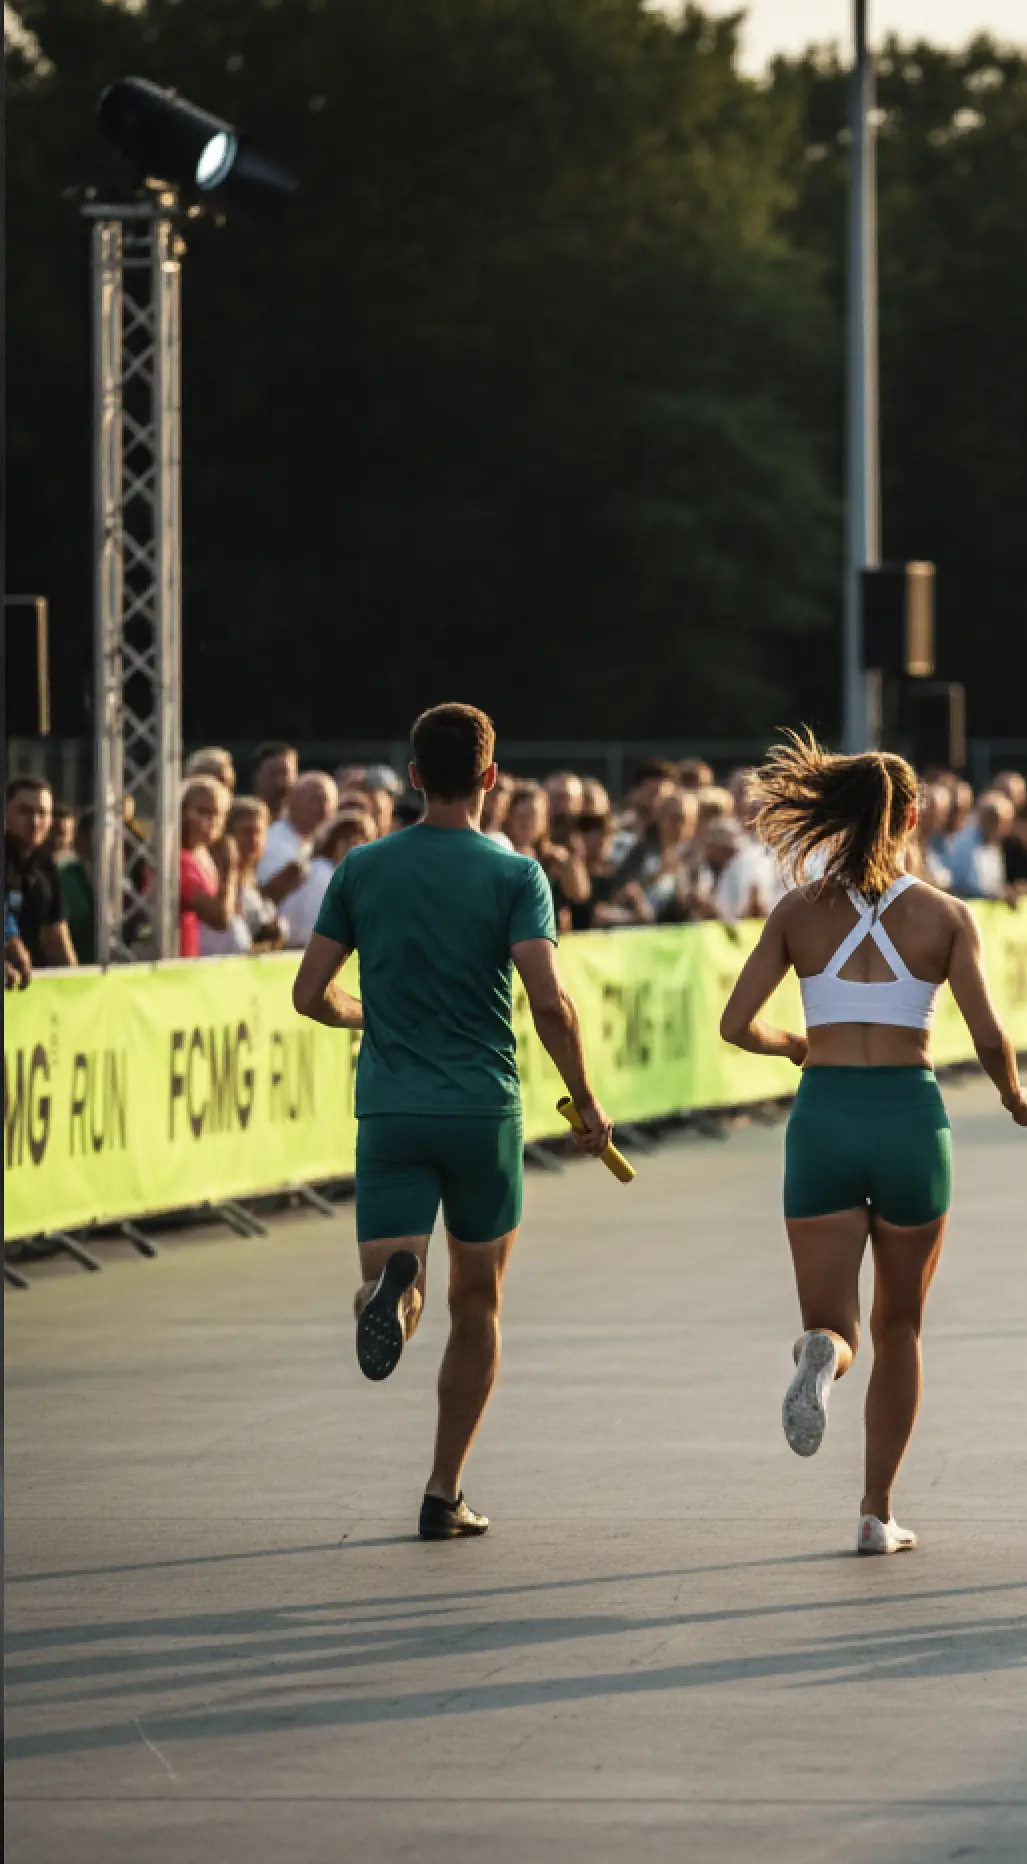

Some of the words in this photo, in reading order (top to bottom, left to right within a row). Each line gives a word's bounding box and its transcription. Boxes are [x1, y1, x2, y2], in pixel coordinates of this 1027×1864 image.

[70, 1051, 127, 1157] RUN
[168, 1020, 254, 1142] FCMG
[270, 1030, 315, 1122] RUN
